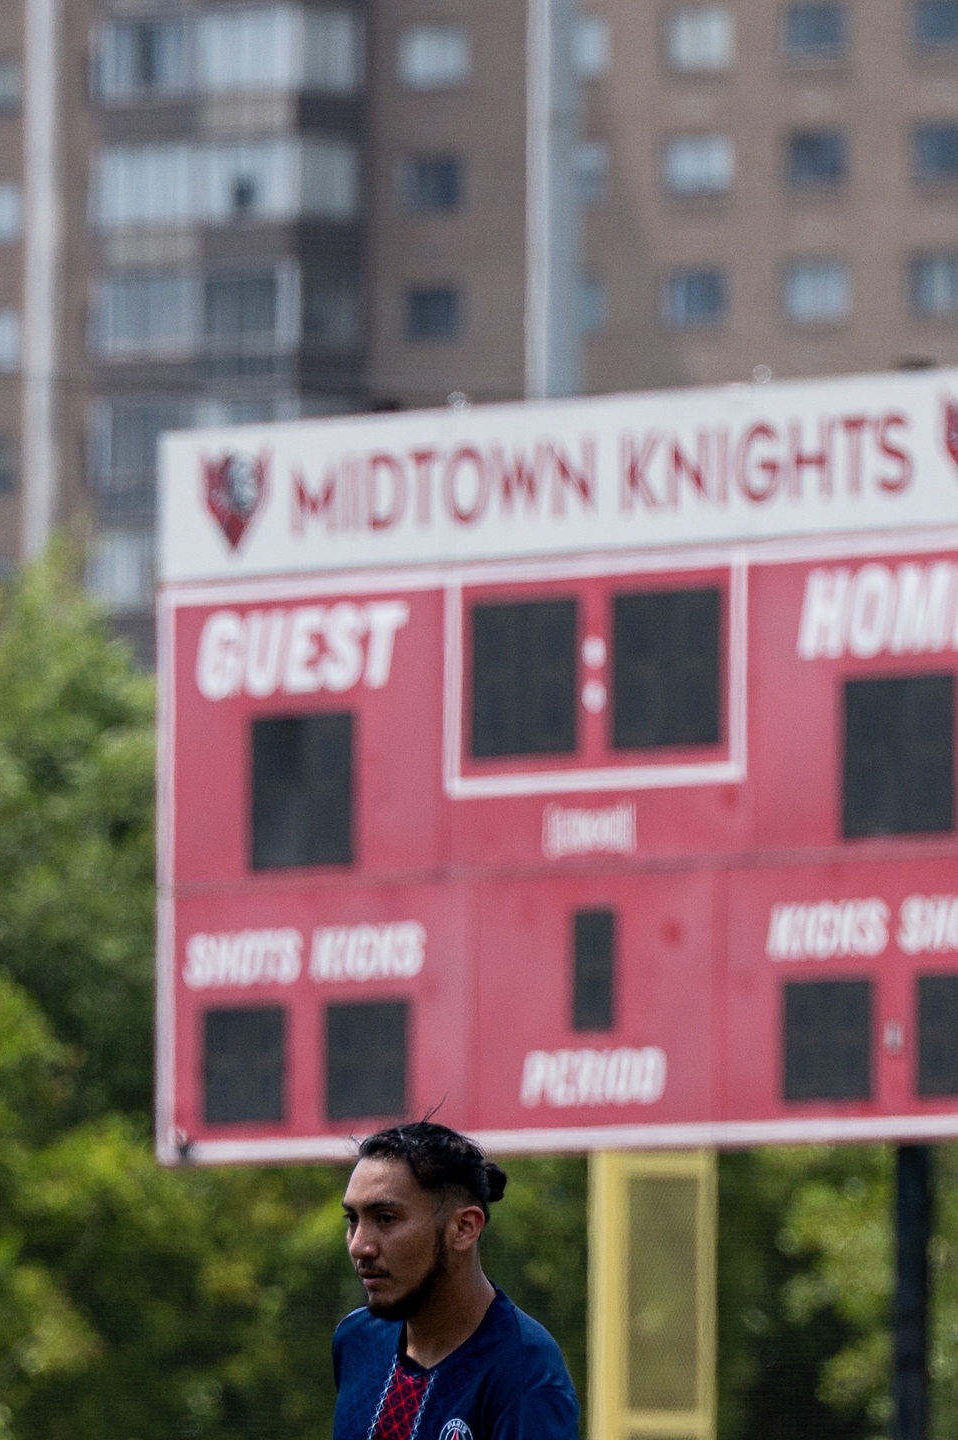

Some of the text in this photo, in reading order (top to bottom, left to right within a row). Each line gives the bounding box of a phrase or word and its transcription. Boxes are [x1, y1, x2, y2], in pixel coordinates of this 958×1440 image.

[289, 410, 913, 538] MIDTOWN KNIGHTS
[796, 559, 958, 660] HOM
[197, 601, 410, 700] GUEST
[183, 921, 426, 990] SHOTS KICKS
[765, 897, 889, 962] KICKS
[520, 1046, 667, 1107] PERIOD
[447, 1420, 468, 1434] PARIS
